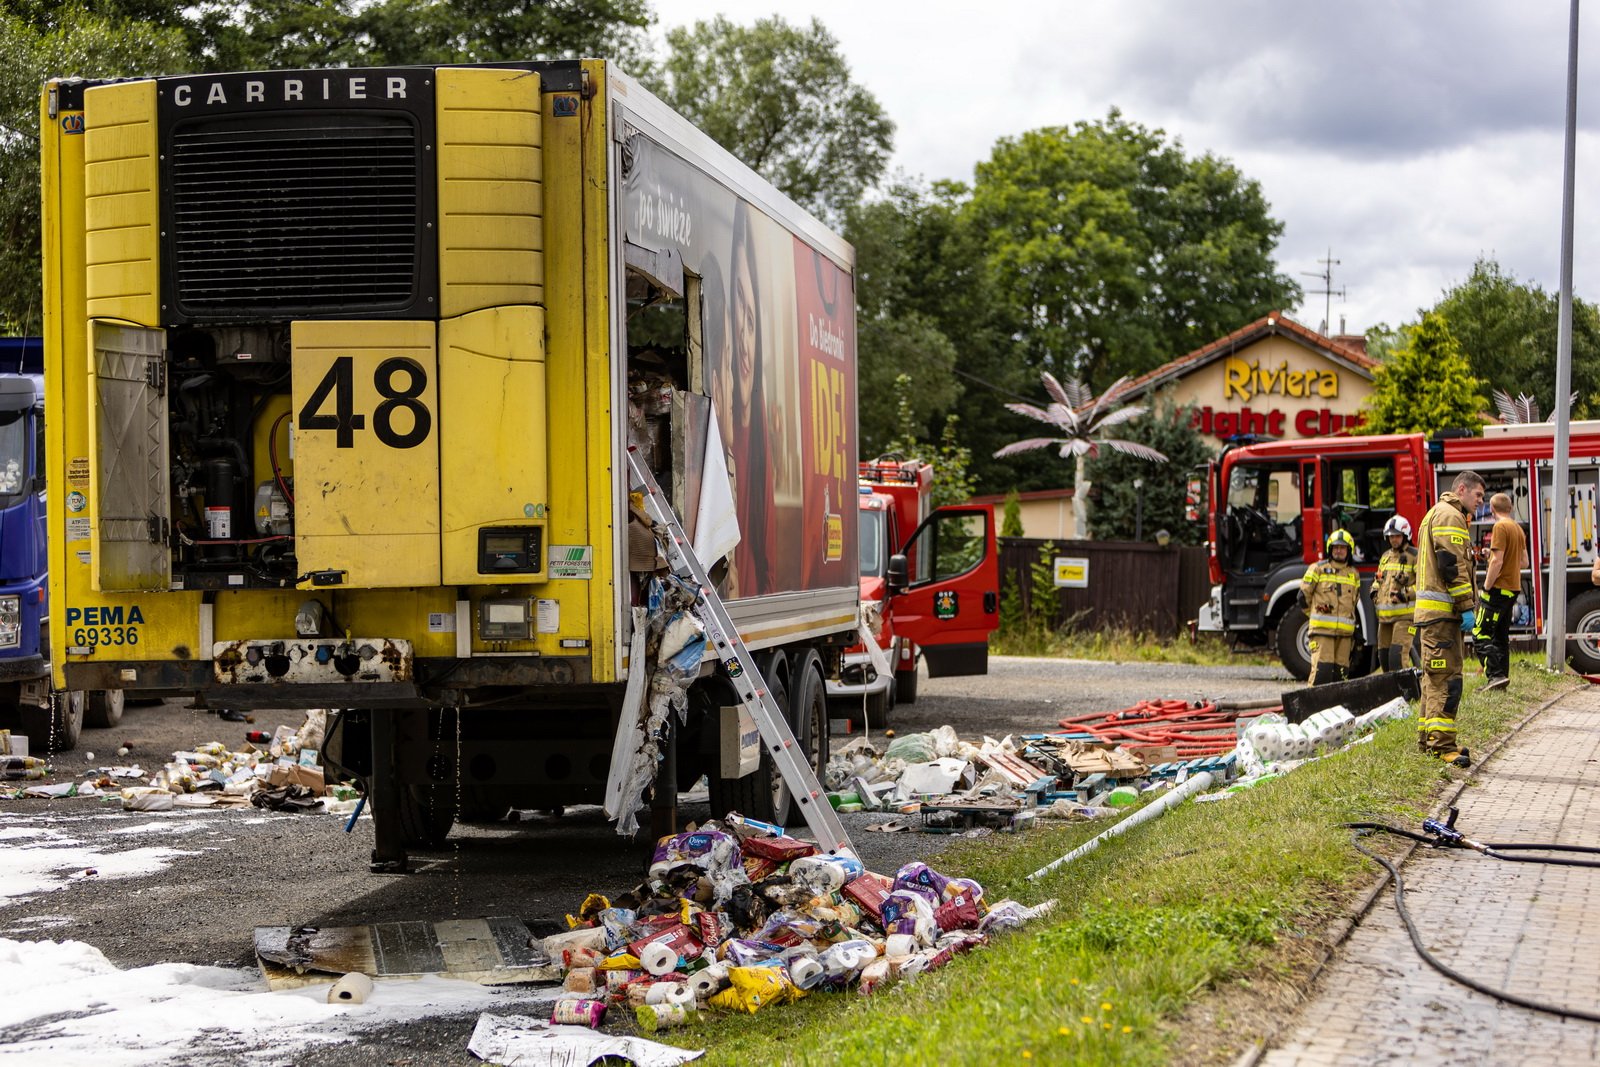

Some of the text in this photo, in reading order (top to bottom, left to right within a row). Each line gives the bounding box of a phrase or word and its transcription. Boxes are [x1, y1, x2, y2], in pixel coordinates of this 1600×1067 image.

[174, 76, 408, 107] CARRIER
[639, 184, 692, 247] po świeże
[809, 312, 846, 361] Do Biedronki
[297, 355, 432, 449] 48
[1223, 357, 1340, 403] Riviera
[810, 357, 847, 509] IDĘ!
[66, 605, 145, 626] PEMA
[74, 626, 138, 646] 69336
